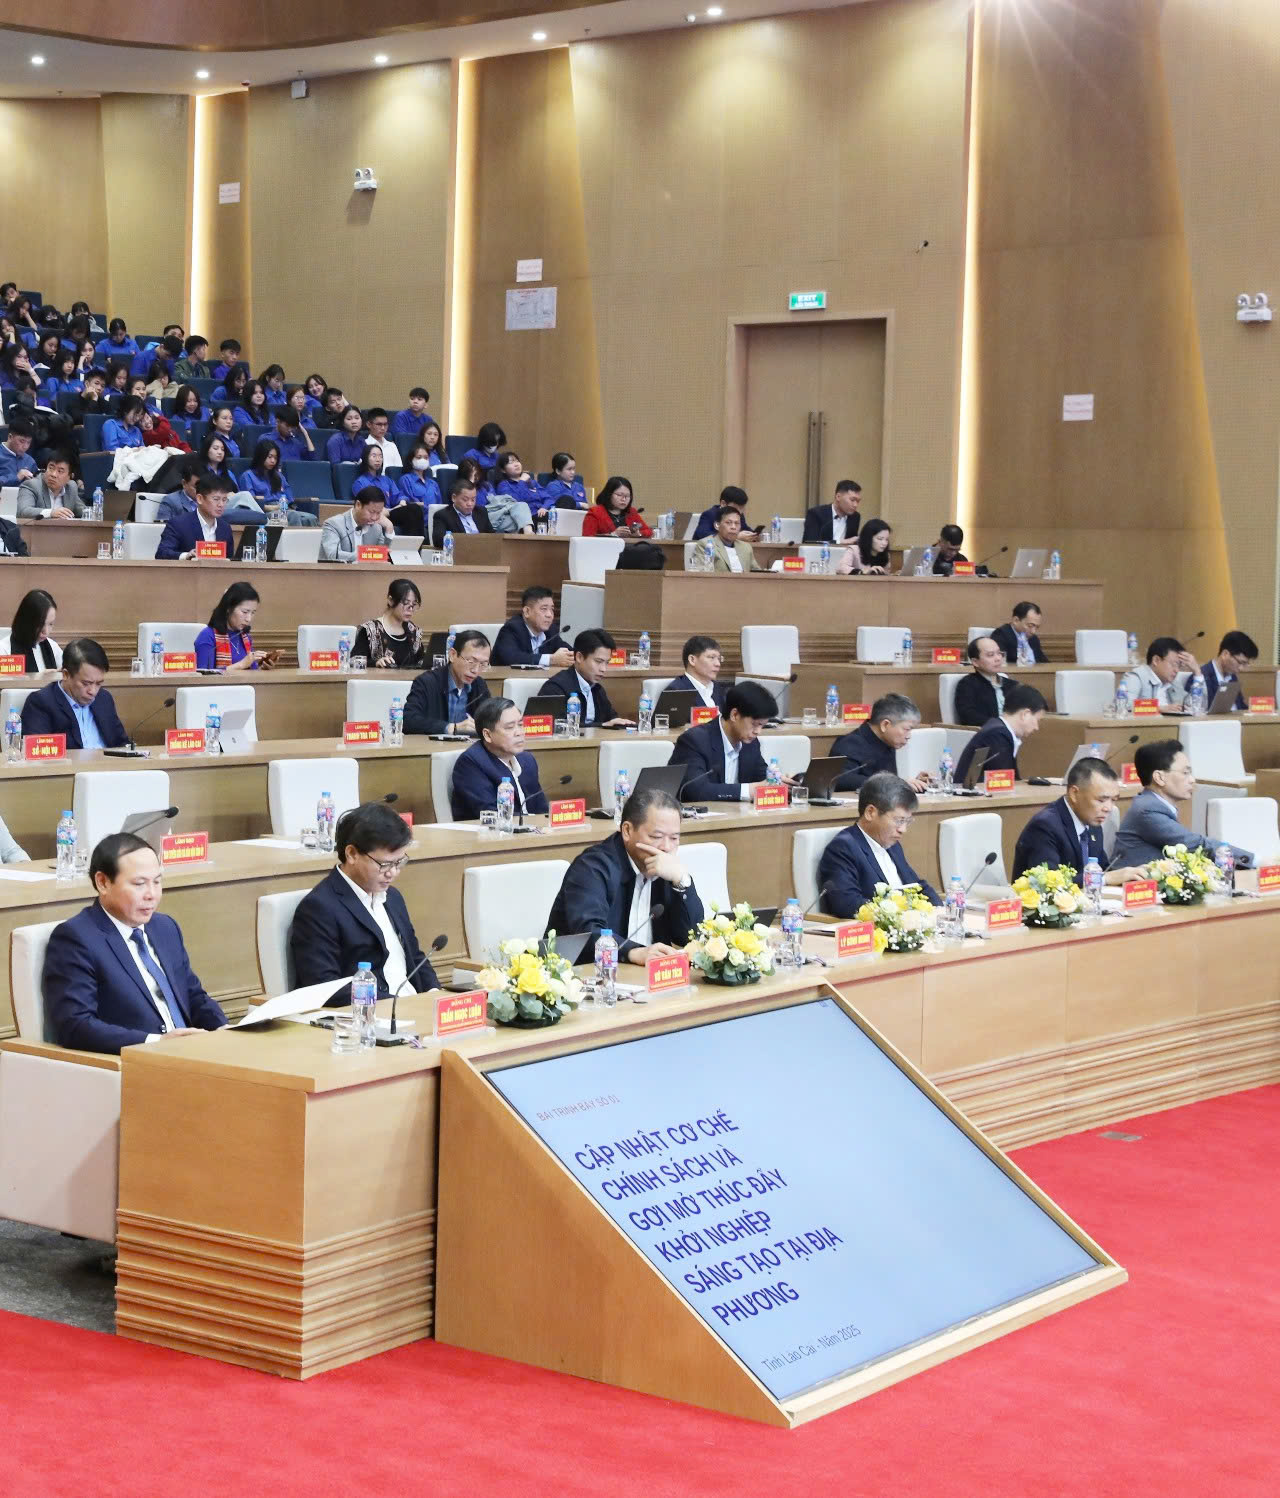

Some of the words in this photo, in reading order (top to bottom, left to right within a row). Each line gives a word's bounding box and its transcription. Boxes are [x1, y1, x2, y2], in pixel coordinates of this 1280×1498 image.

[574, 1144, 615, 1171] CẬP
[614, 1130, 670, 1160] NHẬT
[666, 1122, 699, 1145] CƠ
[696, 1108, 740, 1137] CHẾ
[602, 1170, 666, 1200] CHÍNH
[660, 1156, 716, 1184] SÁCH
[708, 1144, 744, 1169] VÀ
[628, 1204, 672, 1231] GỢI
[664, 1192, 702, 1220] MỞ
[696, 1180, 752, 1209] THÚC
[746, 1168, 788, 1195] ĐẨY
[654, 1230, 711, 1262] KHỞI
[703, 1209, 772, 1247] NGHIỆP
[684, 1264, 743, 1294] SÁNG
[735, 1248, 781, 1274] TẠO
[774, 1236, 813, 1261] TẠI
[804, 1227, 844, 1251] ĐỊA
[712, 1281, 800, 1326] PHƯƠNG
[798, 1344, 818, 1356] Cai
[838, 1324, 861, 1340] 2025
